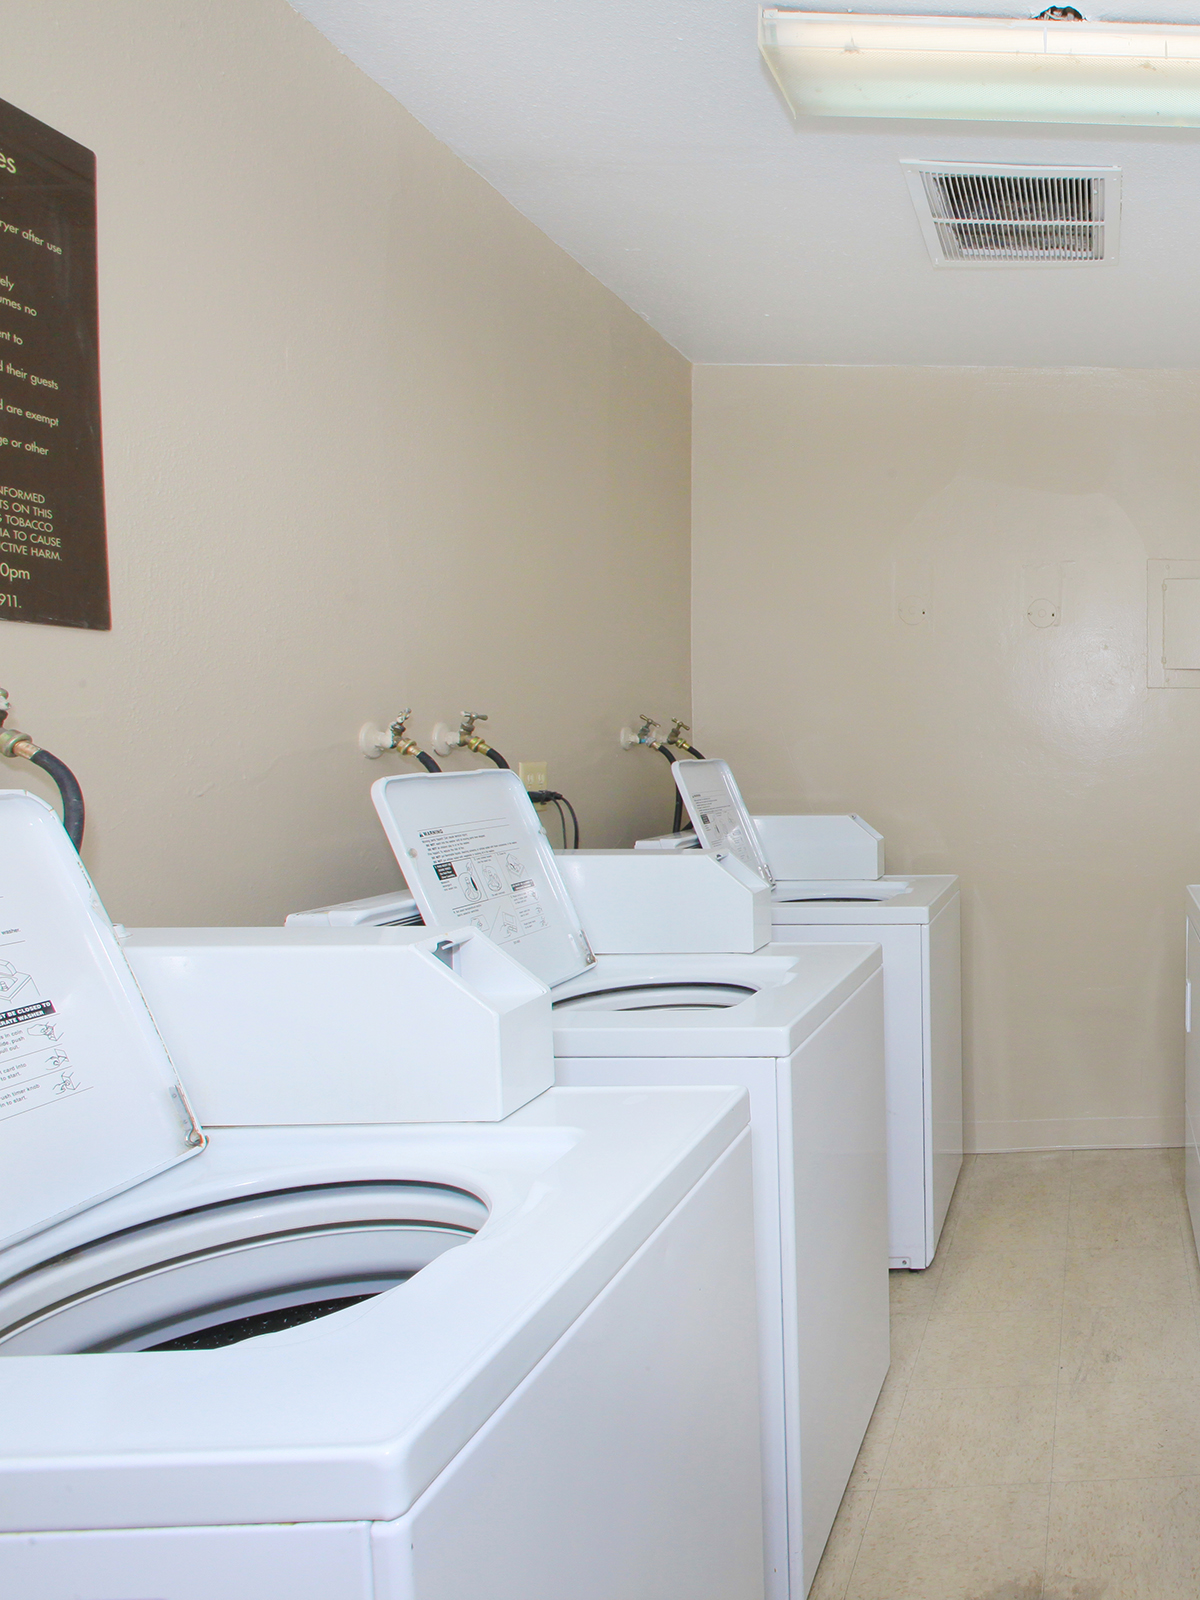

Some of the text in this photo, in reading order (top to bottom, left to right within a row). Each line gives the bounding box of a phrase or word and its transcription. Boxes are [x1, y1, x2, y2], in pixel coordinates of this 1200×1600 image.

[0, 152, 17, 174] es
[21, 229, 44, 246] after
[46, 242, 63, 255] use
[24, 305, 38, 317] no
[0, 331, 24, 346] nt to
[6, 363, 28, 379] their
[30, 374, 59, 390] guests
[6, 404, 23, 416] are
[25, 410, 59, 428] exempt
[11, 440, 22, 449] or
[24, 441, 49, 456] other
[12, 502, 30, 515] ON
[33, 506, 53, 520] THIS
[5, 514, 54, 533] TOBACCO
[13, 529, 27, 542] TO
[30, 533, 61, 548] CAUSE
[0, 541, 62, 561] CTIVE HARM.
[0, 562, 30, 582] 0pm
[0, 593, 22, 609] 911.
[7, 1010, 17, 1018] BE
[16, 1003, 42, 1014] CLOSED
[42, 1001, 51, 1009] TO
[0, 1010, 45, 1027] RATE WASHER
[11, 1036, 25, 1045] push
[3, 1066, 16, 1074] card
[26, 1084, 41, 1092] knob
